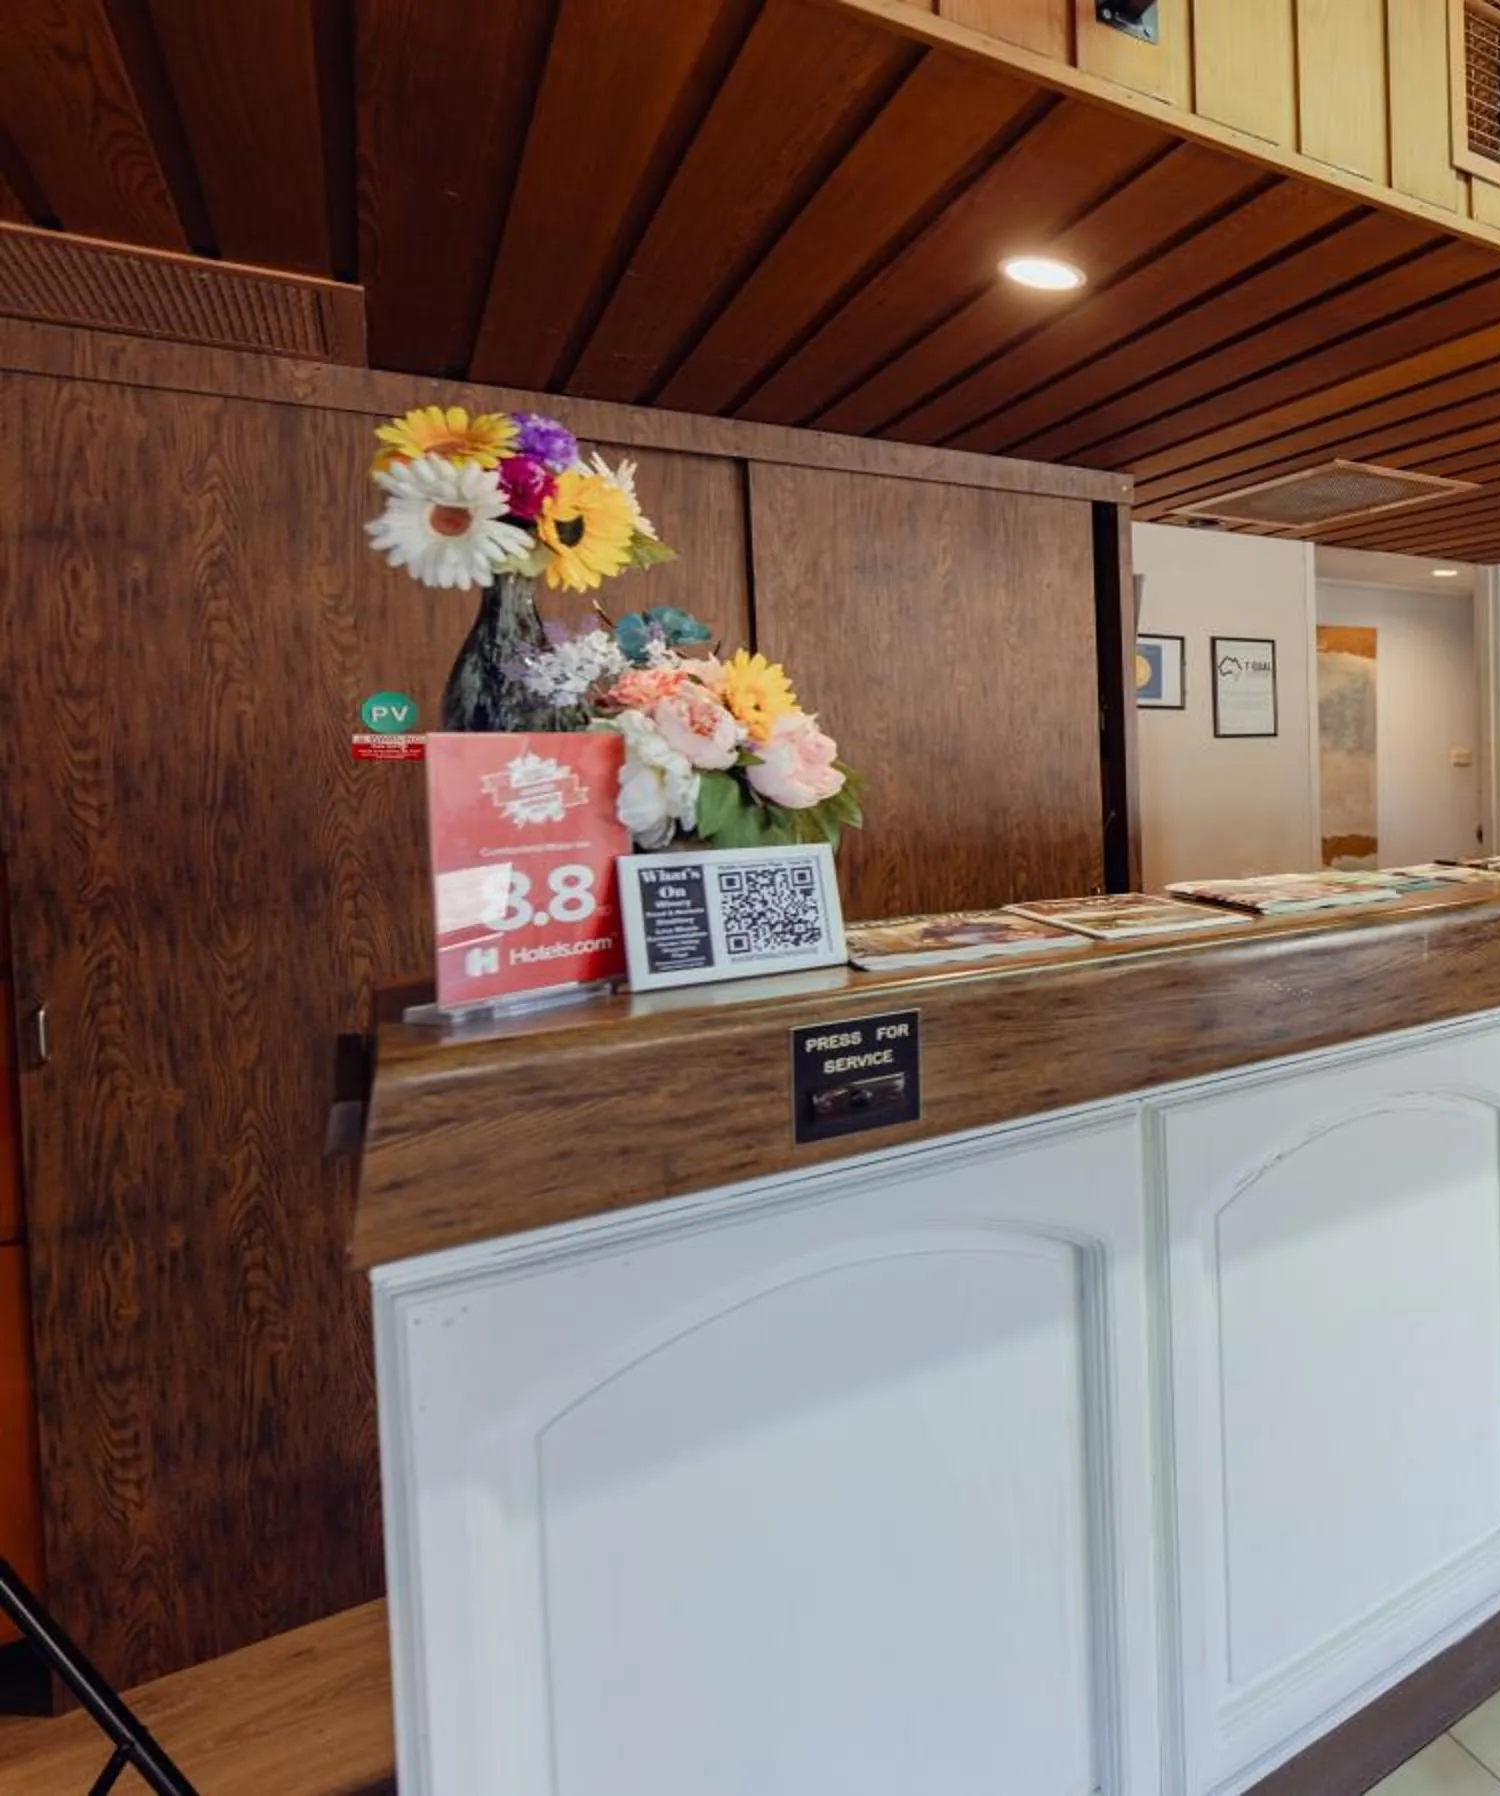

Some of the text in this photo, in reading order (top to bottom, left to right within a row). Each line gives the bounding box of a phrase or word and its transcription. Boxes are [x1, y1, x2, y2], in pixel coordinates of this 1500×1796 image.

[372, 704, 409, 723] PV
[639, 867, 701, 884] What's
[658, 885, 687, 899] On
[509, 936, 613, 966] Hotels.com
[805, 1023, 910, 1053] PRESS FOR
[823, 1049, 895, 1075] SERVICE
